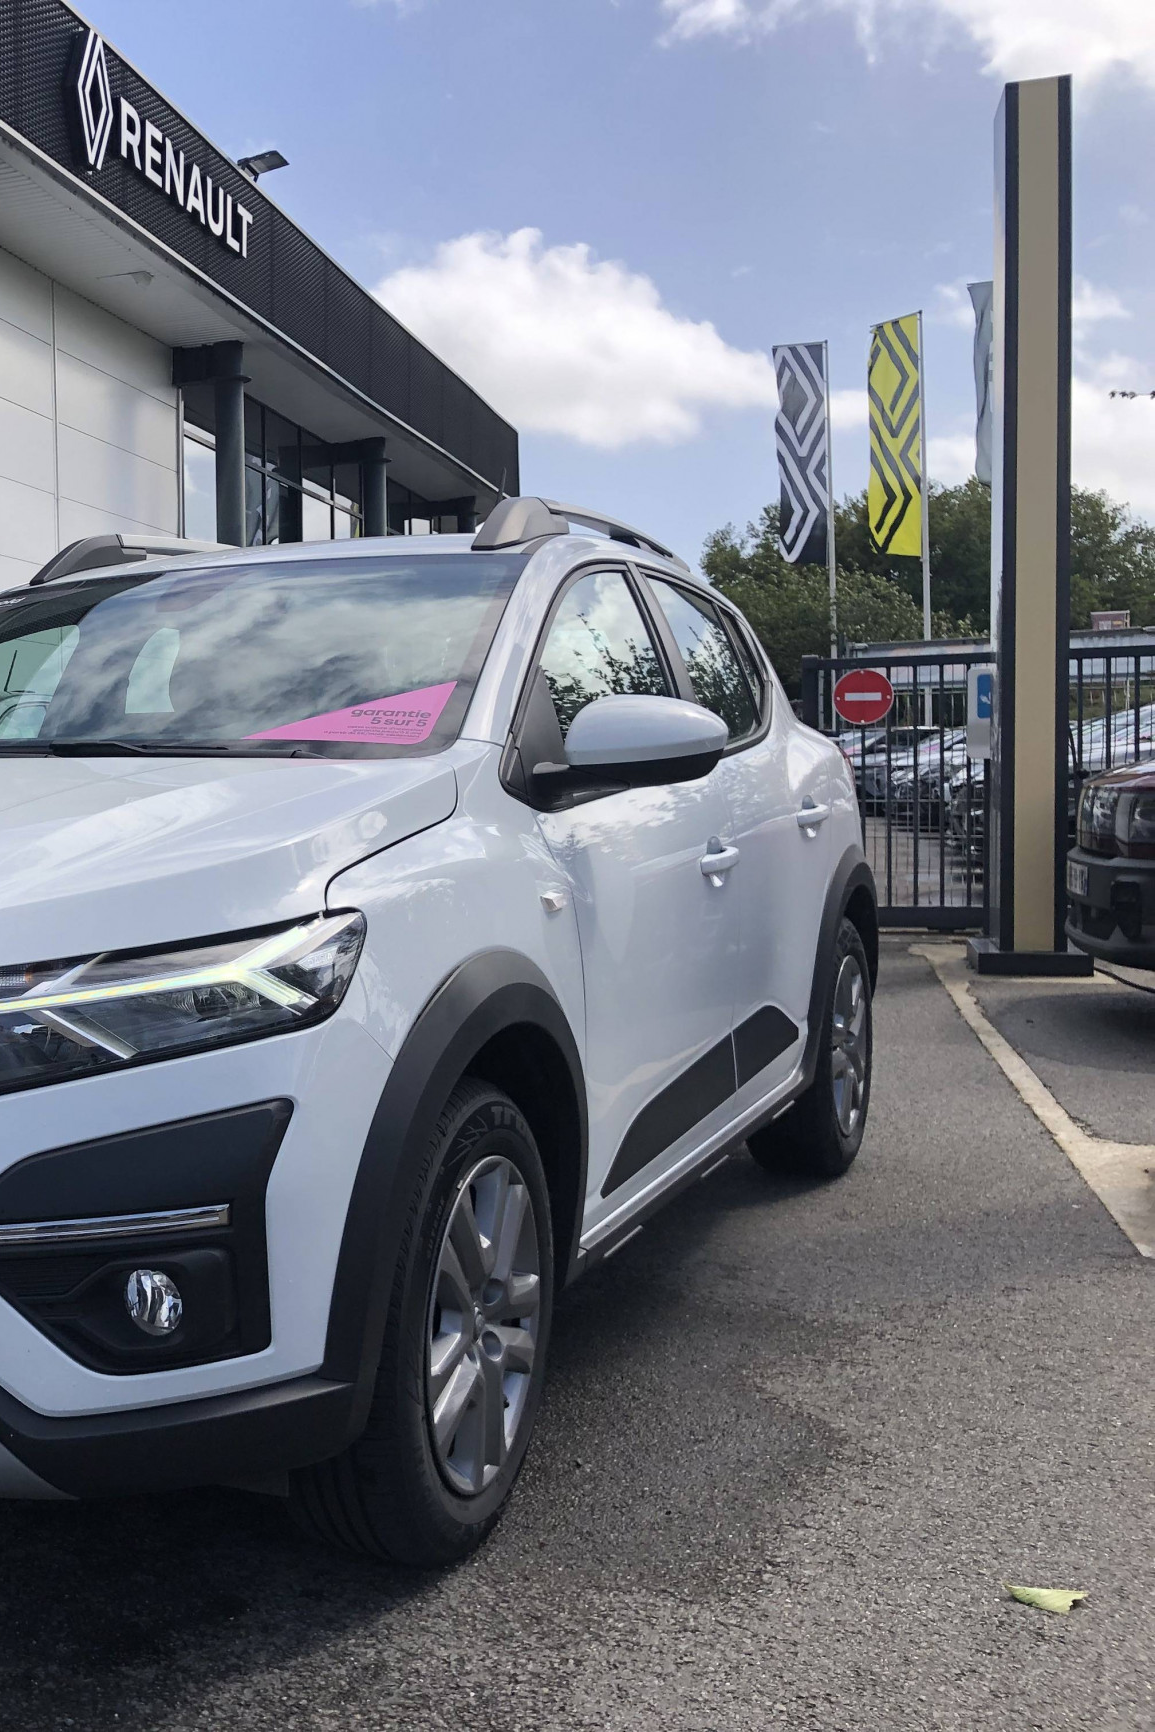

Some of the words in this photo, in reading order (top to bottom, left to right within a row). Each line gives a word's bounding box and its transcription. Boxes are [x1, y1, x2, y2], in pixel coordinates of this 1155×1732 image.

[120, 96, 253, 259] RENAULT
[351, 708, 431, 718] garantie
[371, 717, 381, 725] 5
[384, 719, 415, 727] sur
[416, 719, 427, 727] 5
